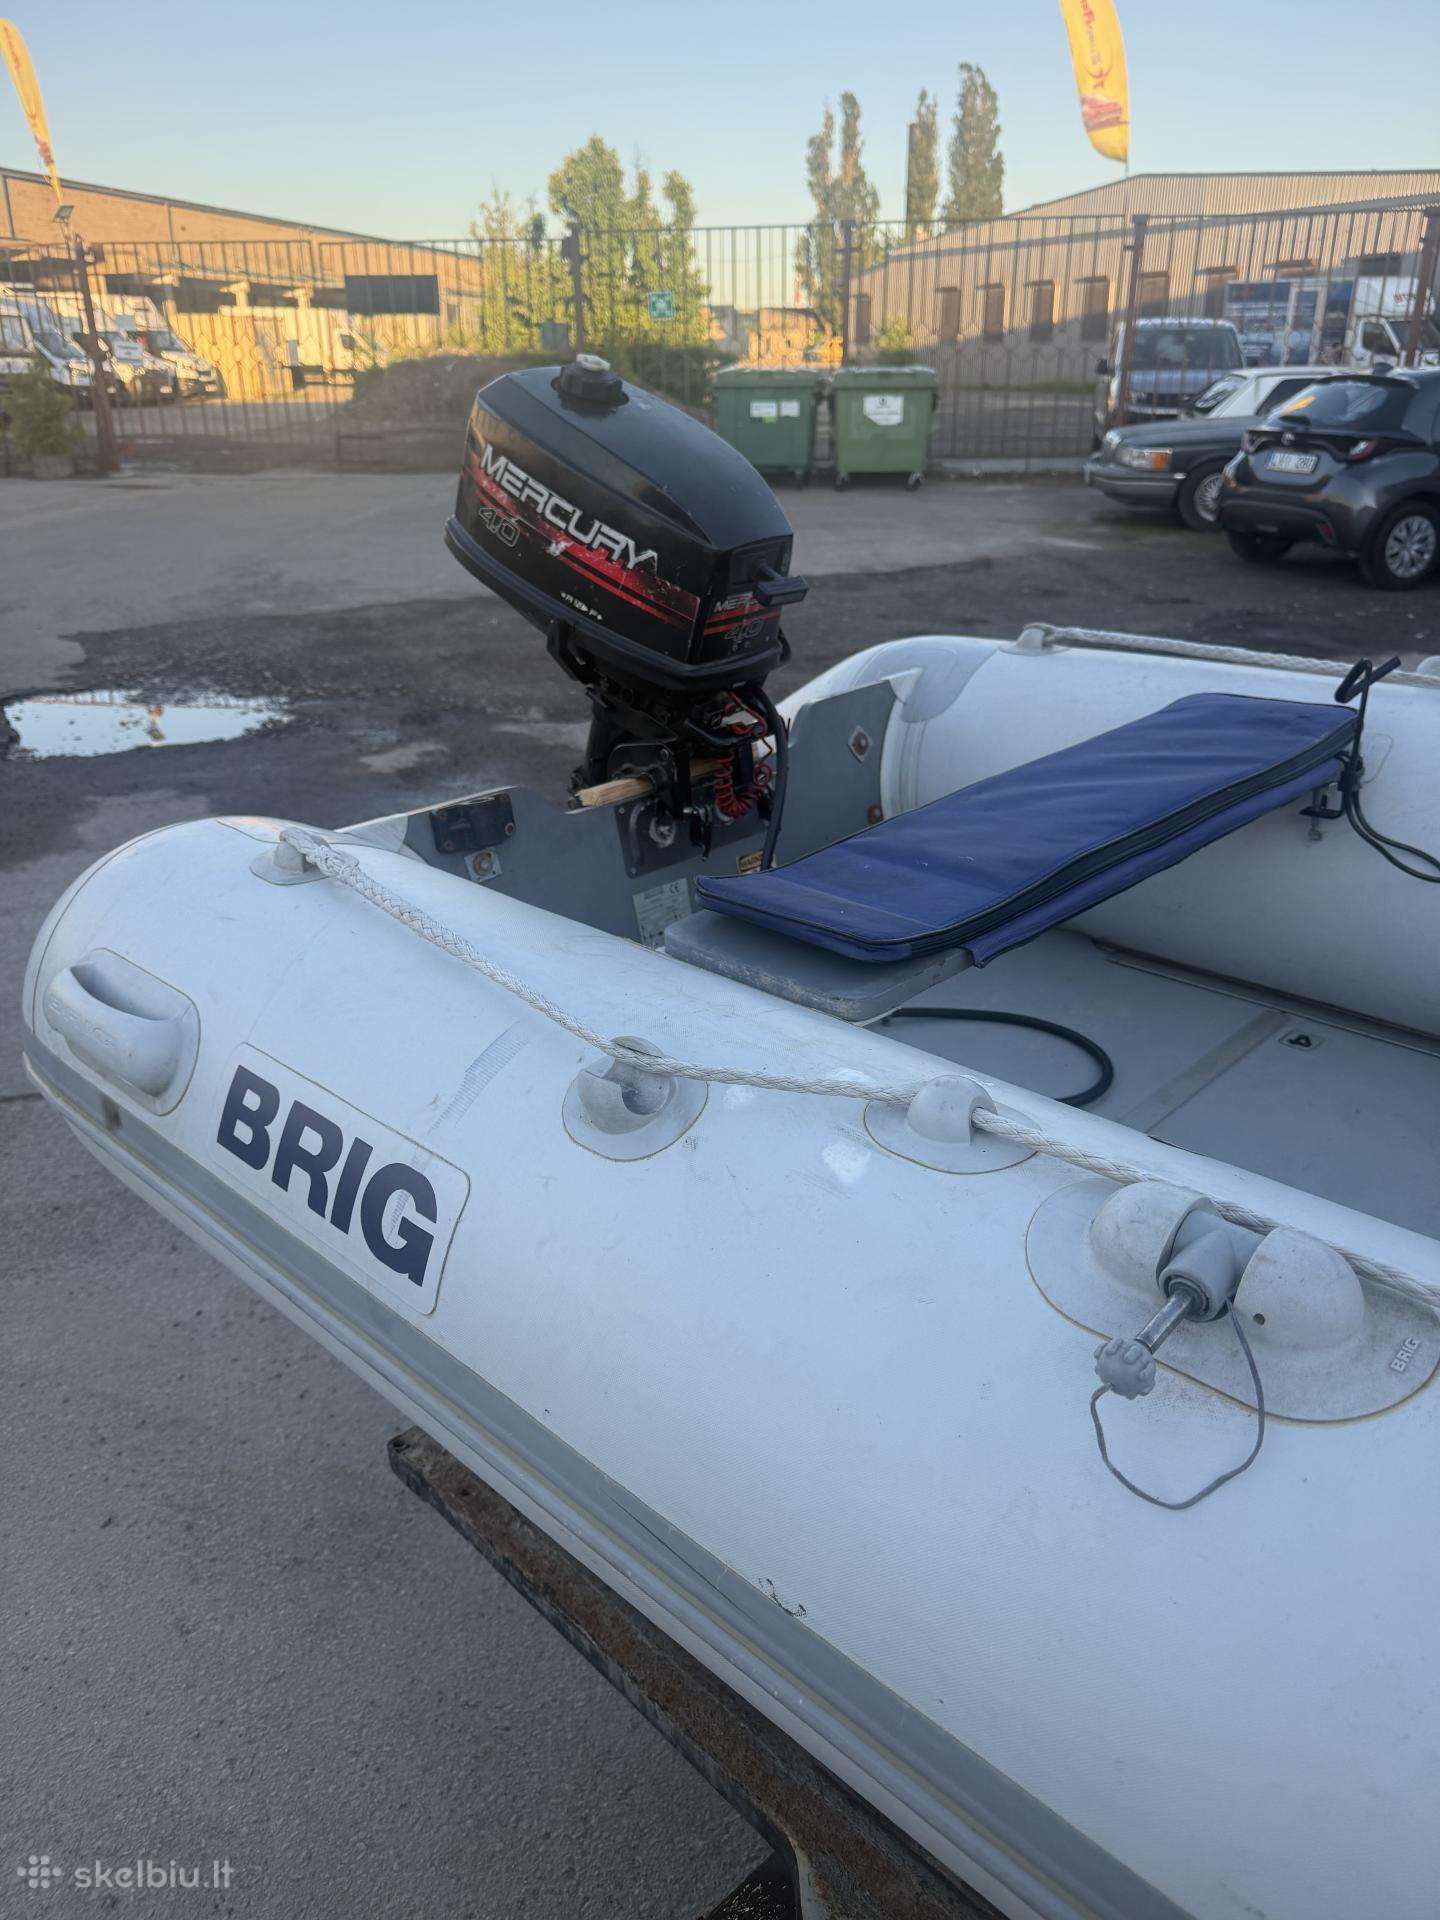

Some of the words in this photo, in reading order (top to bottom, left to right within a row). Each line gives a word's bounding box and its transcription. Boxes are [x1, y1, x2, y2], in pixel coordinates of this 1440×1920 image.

[479, 507, 520, 547] 40
[480, 444, 657, 571] MERCURY
[217, 1064, 438, 1288] BRIG
[1390, 1336, 1420, 1372] BRIG
